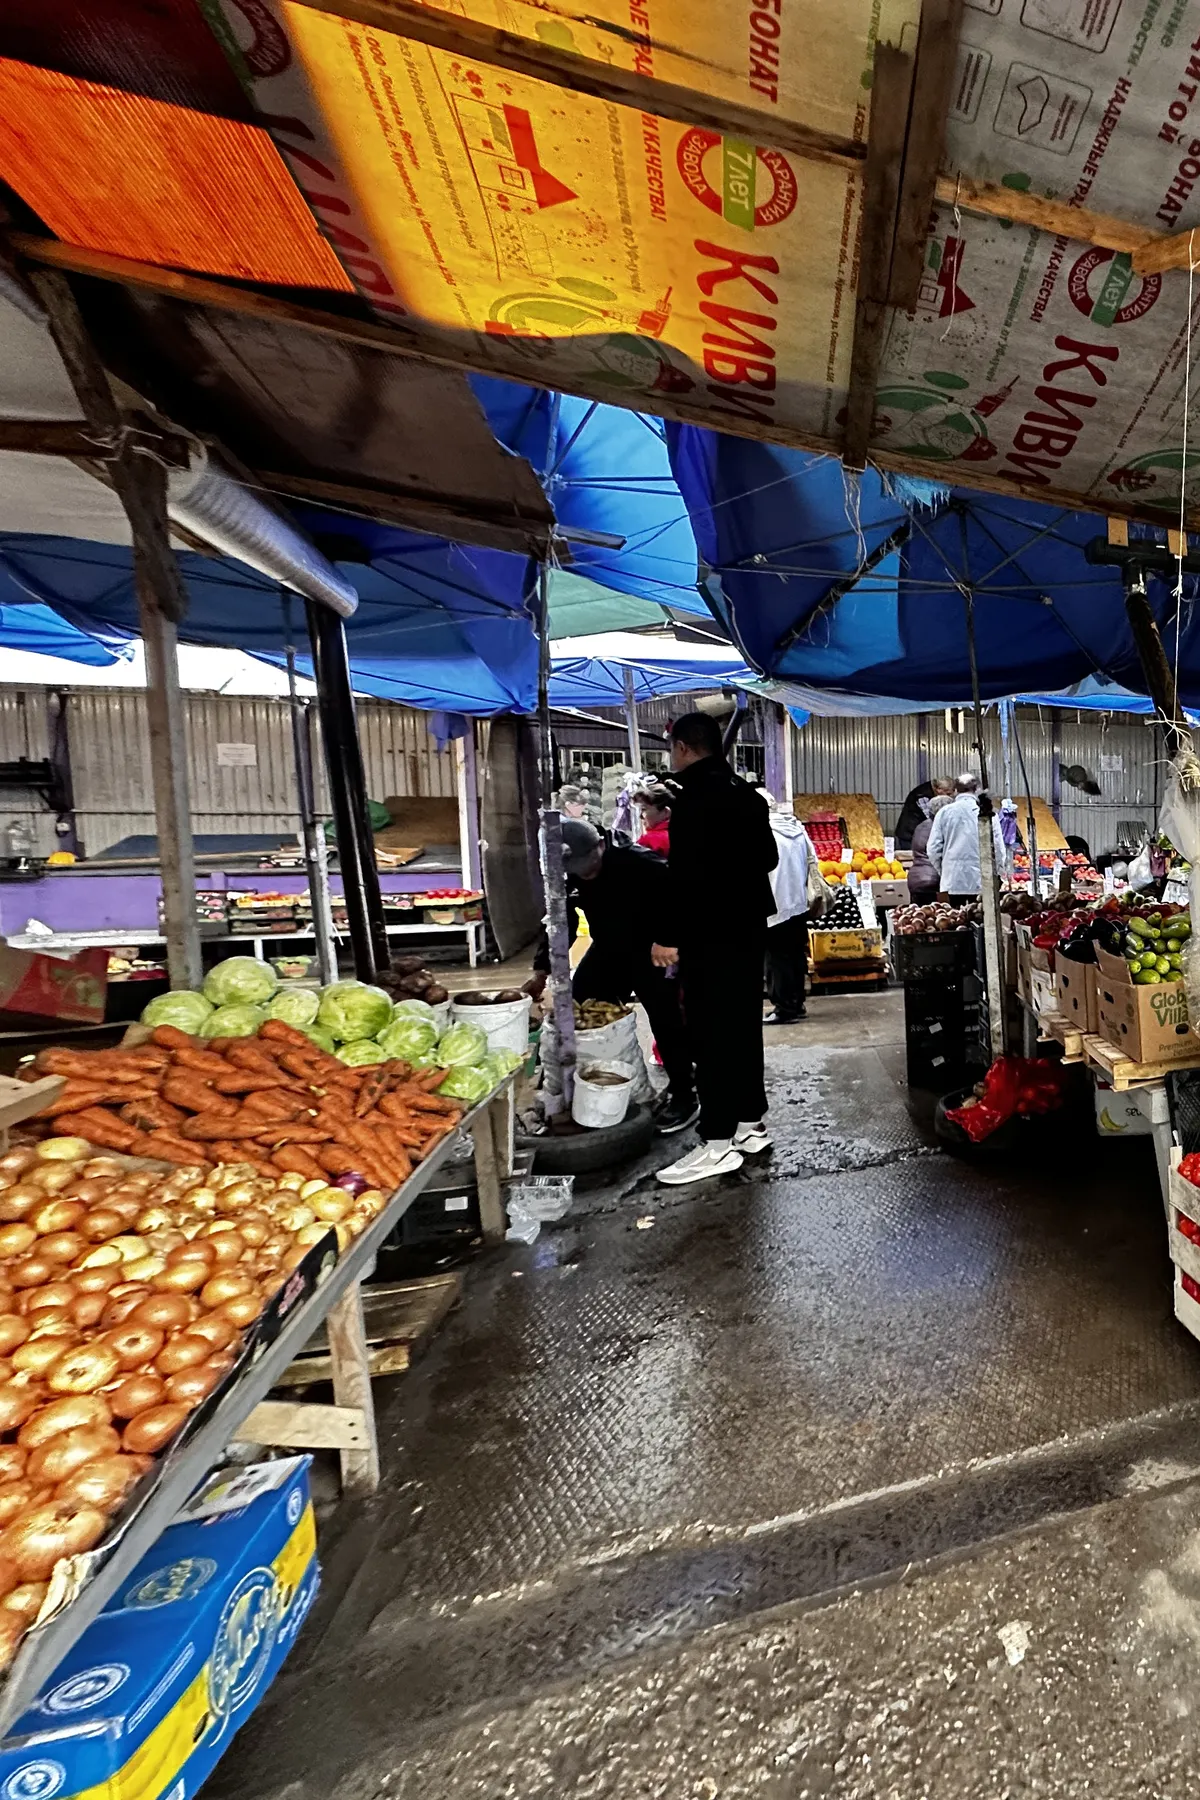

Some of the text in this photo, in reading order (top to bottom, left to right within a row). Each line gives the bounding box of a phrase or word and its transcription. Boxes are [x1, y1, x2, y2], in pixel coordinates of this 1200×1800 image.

[1081, 75, 1133, 178] НАДЕЖНЫЕ
[641, 126, 668, 223] КАЧЕСТВА!
[684, 133, 707, 196] ЗАВОДА
[1027, 250, 1065, 324] КАЧЕСТВА!
[1070, 253, 1100, 301] ЗАВОДА
[1120, 276, 1159, 321] РАНТИЯ
[694, 238, 780, 425] КИВИ
[997, 335, 1120, 485] КИВИ
[1158, 1038, 1192, 1052] Premium
